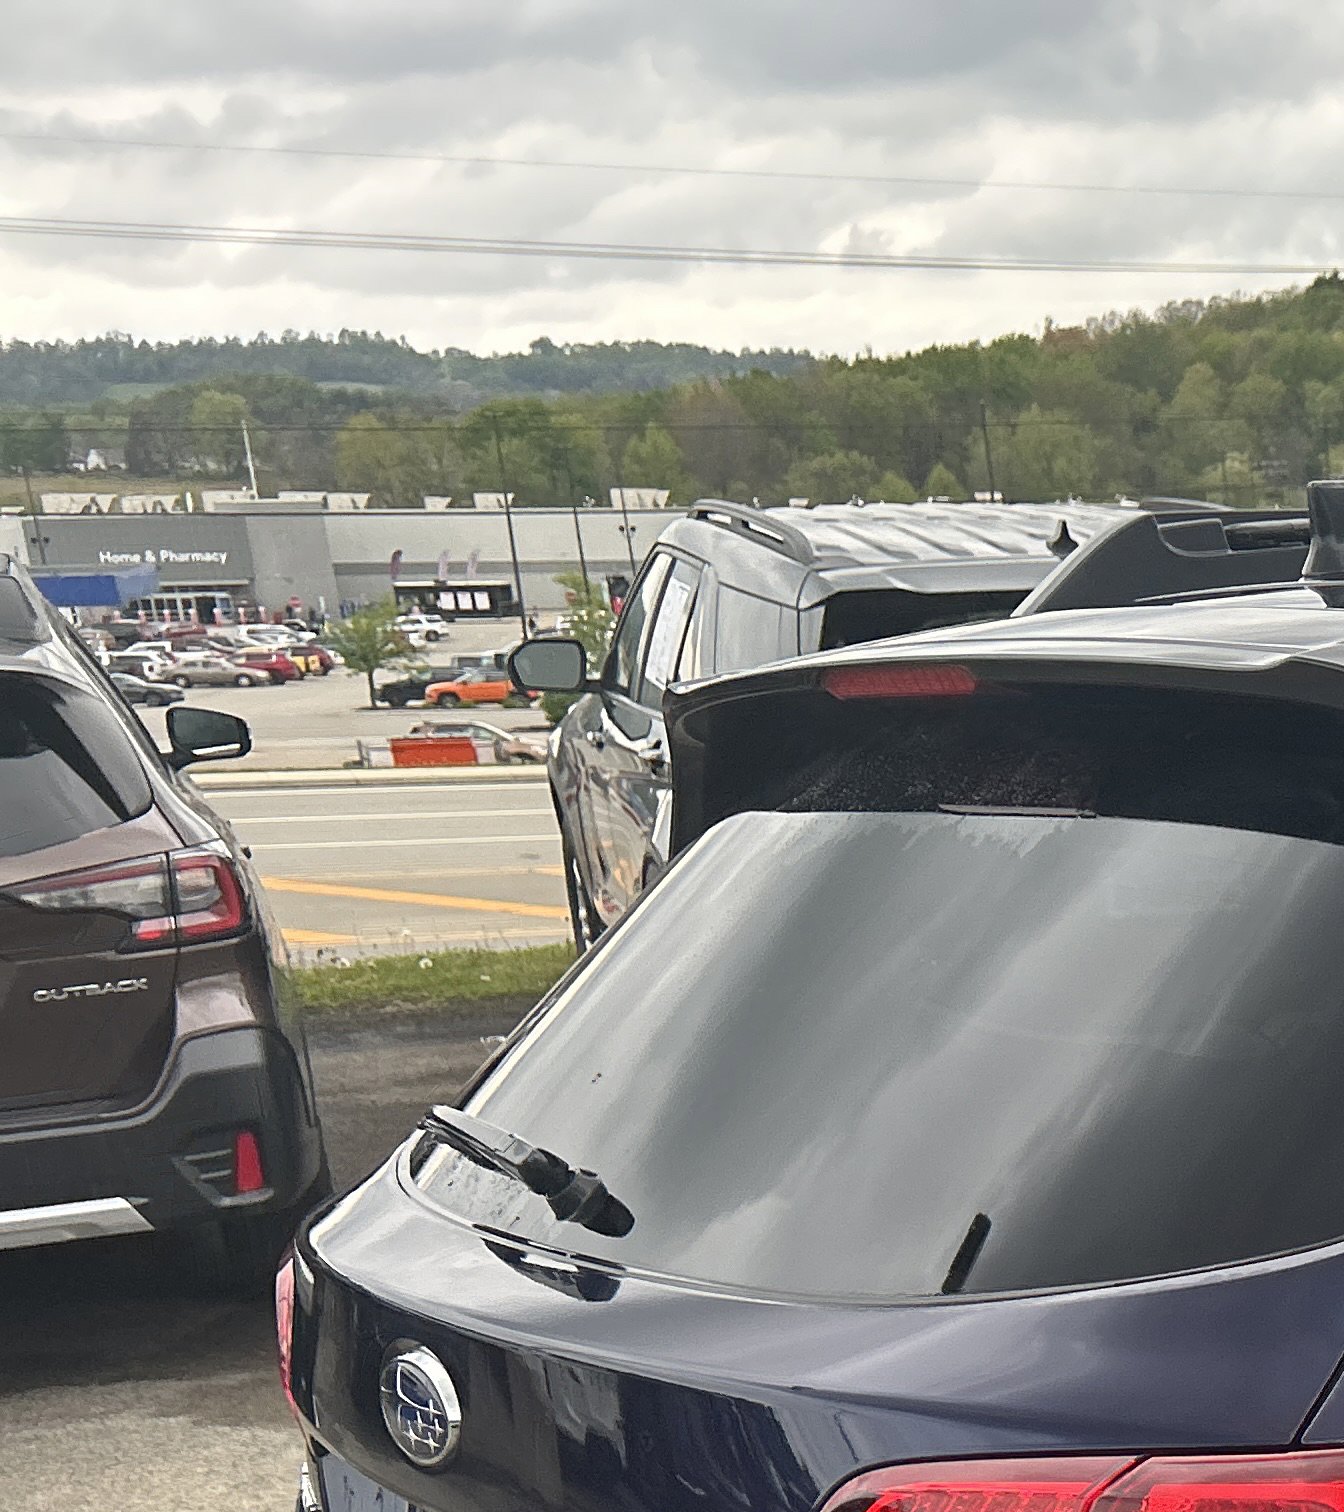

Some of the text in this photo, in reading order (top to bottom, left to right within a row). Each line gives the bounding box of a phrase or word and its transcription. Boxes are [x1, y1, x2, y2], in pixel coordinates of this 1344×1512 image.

[99, 549, 228, 565] Home & Pharmacy
[33, 977, 149, 1002] OUTBACK
